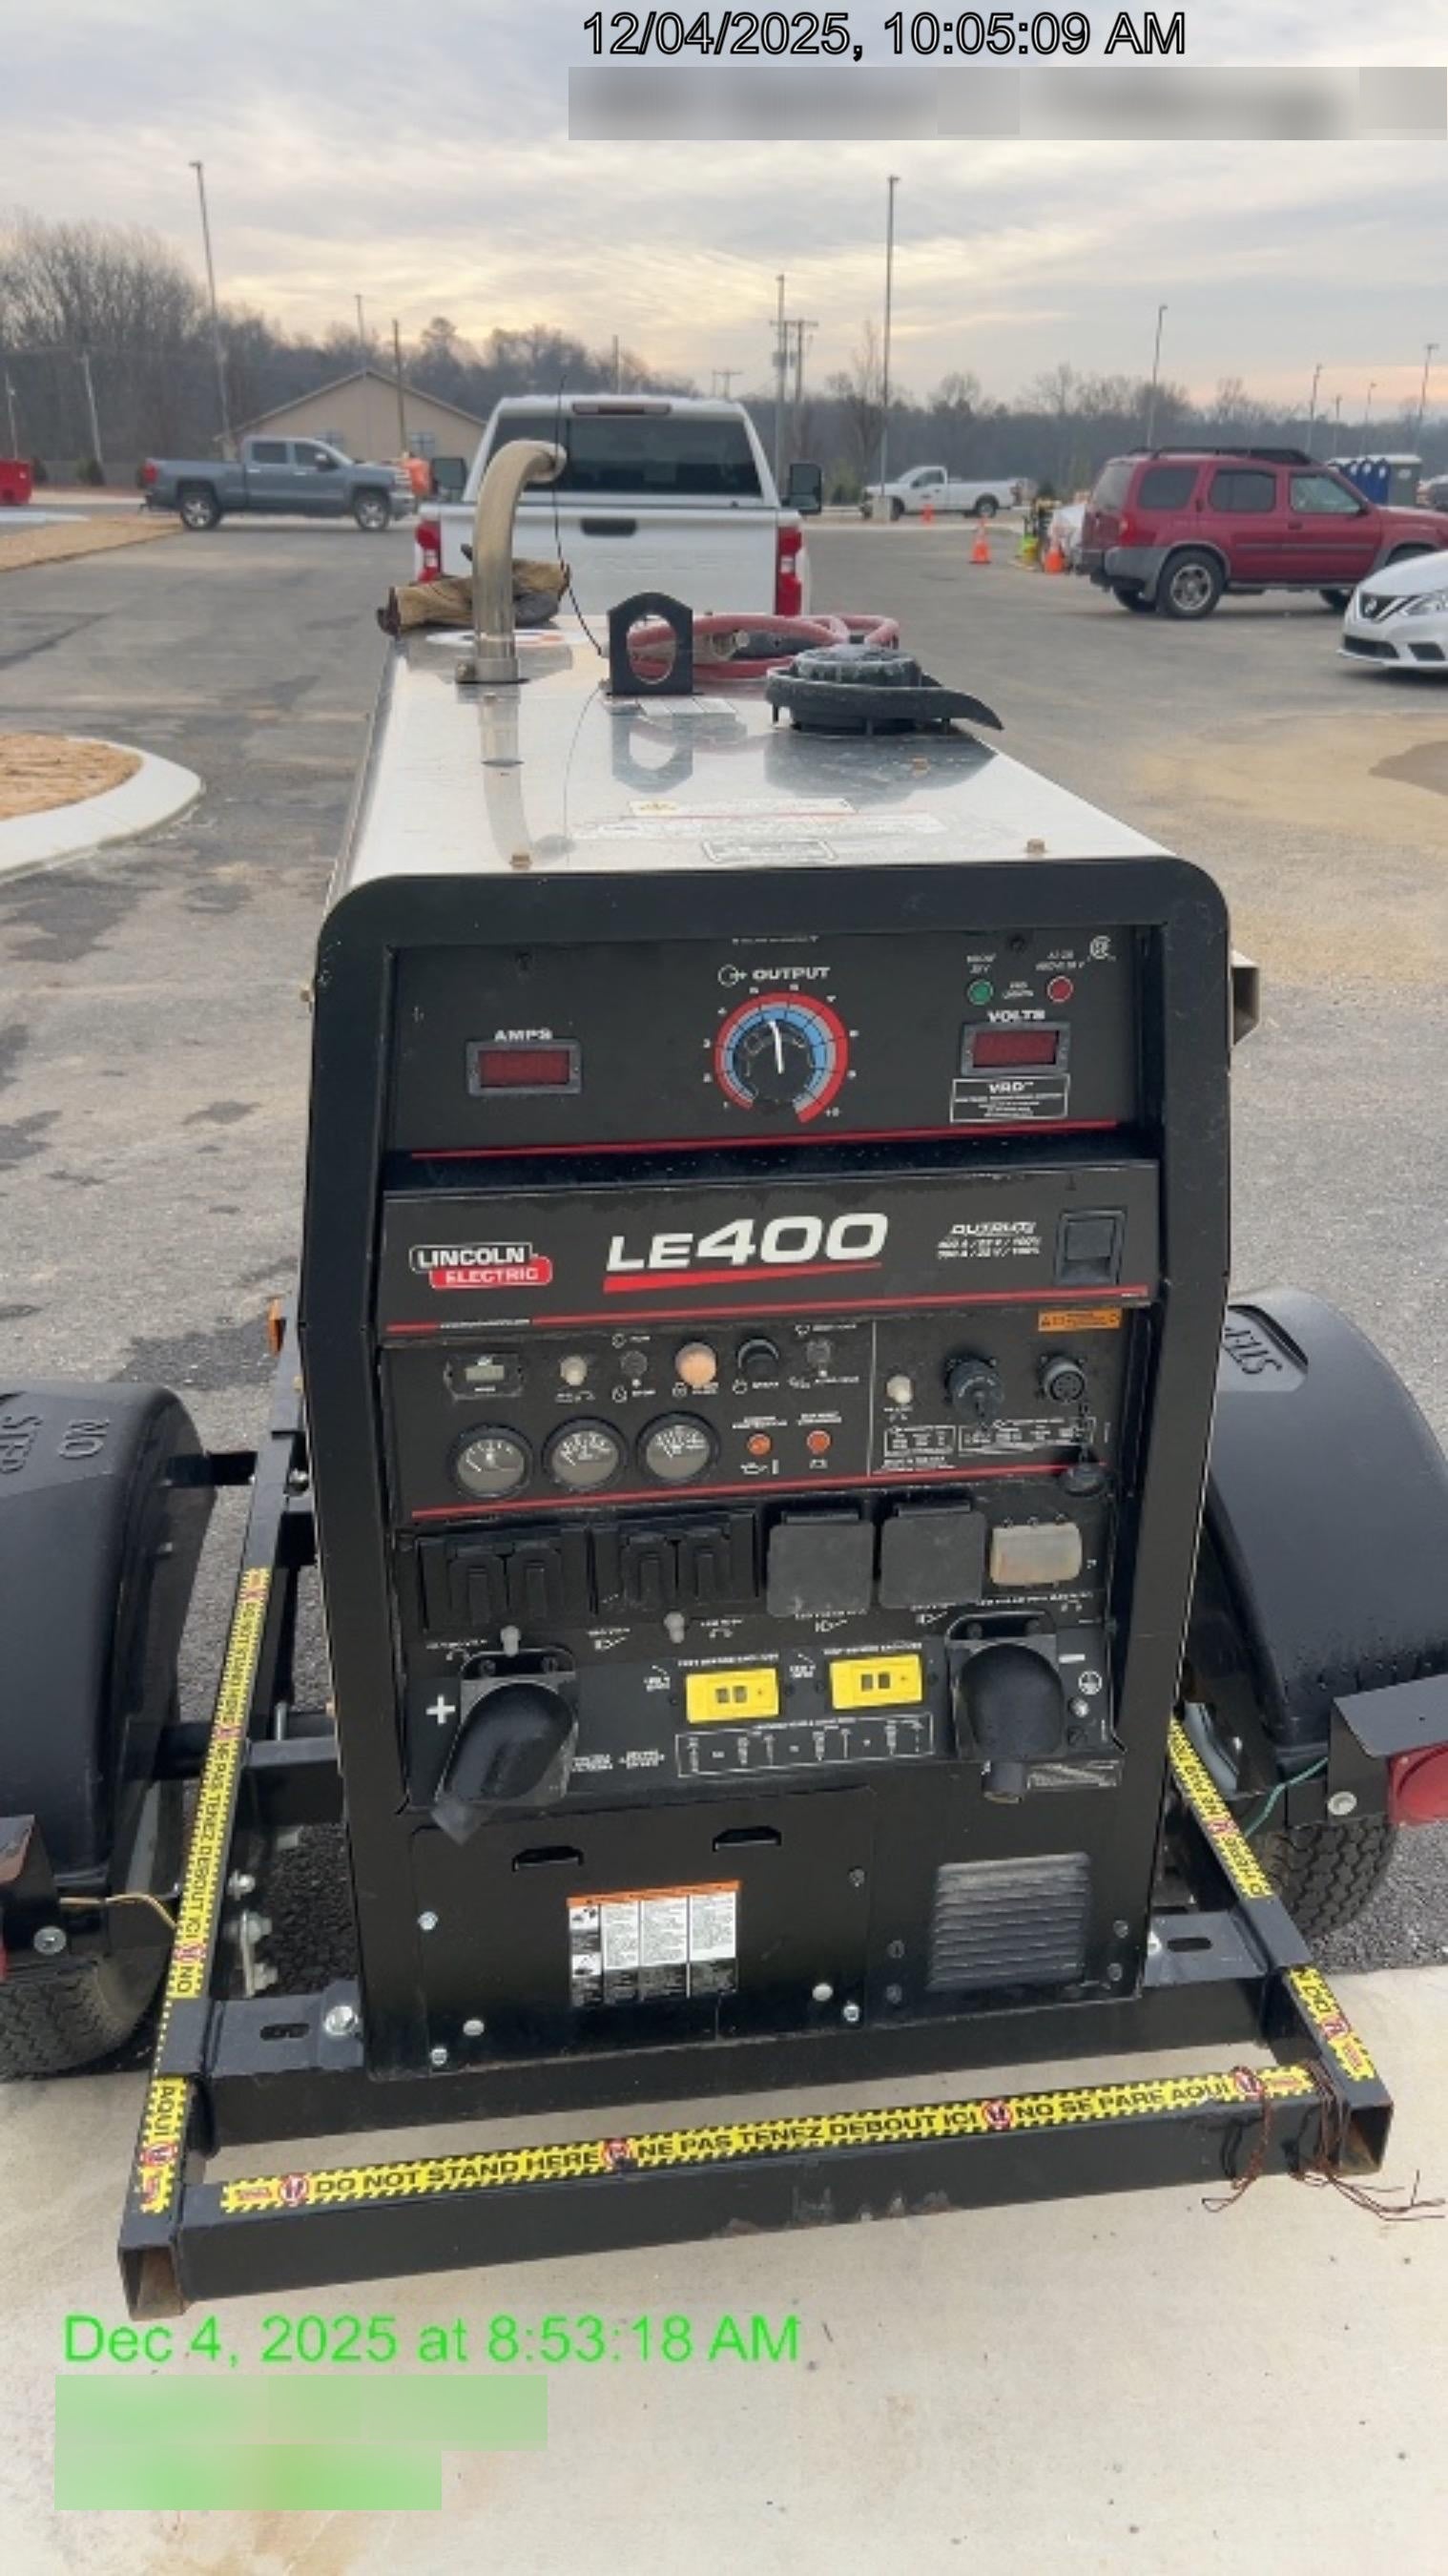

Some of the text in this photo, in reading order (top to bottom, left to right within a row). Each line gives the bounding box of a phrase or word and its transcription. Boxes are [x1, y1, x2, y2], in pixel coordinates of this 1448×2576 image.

[752, 966, 830, 981] OUTPUT
[987, 1009, 1045, 1023] VOLTS
[494, 1028, 553, 1042] AMPS
[607, 1212, 889, 1272] LE400
[417, 1246, 527, 1267] LINCOLN
[445, 1267, 539, 1286] ELECTRIC
[58, 1419, 111, 1461] NO
[176, 1964, 196, 1993] NO
[154, 2086, 176, 2137] AQUI
[314, 2080, 1230, 2194] DO NOT STAND HERE NE PAS TENEZ DEBOUT ICI NO SE PARE AQUI
